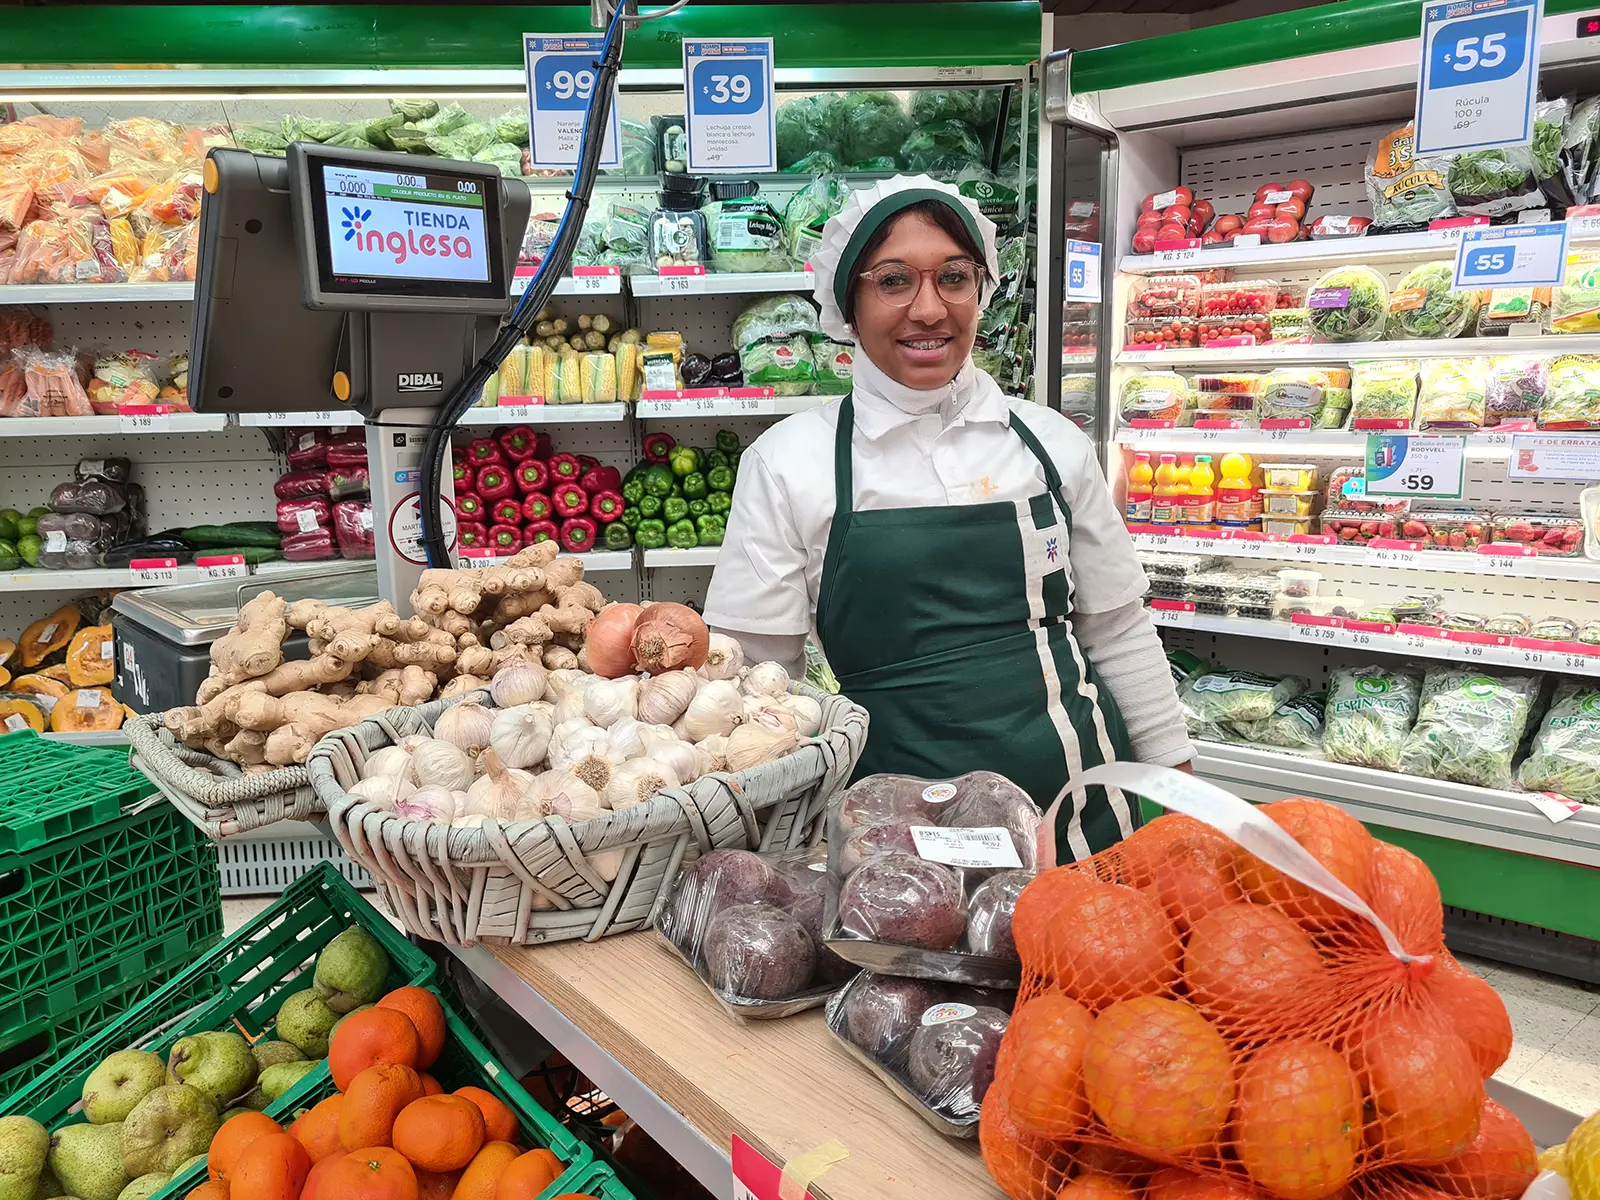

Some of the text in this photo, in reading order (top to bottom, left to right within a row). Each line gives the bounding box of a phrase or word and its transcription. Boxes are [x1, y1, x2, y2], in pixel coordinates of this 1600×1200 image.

[1455, 96, 1490, 108] Rúcula
[1454, 109, 1482, 119] 100 g
[706, 123, 731, 131] Lechuga
[731, 130, 755, 138] lechuga
[403, 210, 471, 230] TIENDA
[1449, 229, 1461, 239] 69
[355, 221, 473, 264] inglesa
[1162, 251, 1195, 261] KG. $ 124
[586, 280, 601, 289] $ 95
[671, 280, 690, 290] $ 163
[398, 373, 442, 386] DIBAL
[654, 403, 673, 412] $ 152
[697, 401, 715, 410] $ 135
[741, 401, 760, 409] $ 160
[511, 408, 529, 417] $ 108
[132, 418, 152, 427] $ 189
[1271, 431, 1288, 441] $ 97
[1487, 434, 1507, 444] $ 53
[1401, 474, 1434, 491] $59
[1150, 536, 1169, 546] $ 104
[1195, 540, 1215, 550] $ 104
[1296, 546, 1316, 555] $ 109
[1376, 551, 1390, 560] KG.
[1392, 552, 1397, 561] $
[472, 559, 477, 569] $
[478, 559, 491, 569] 207
[1490, 559, 1514, 568] $ 144
[141, 571, 173, 580] KG. $ 113
[221, 569, 227, 577] $
[227, 568, 237, 577] 96
[1161, 612, 1179, 621] $ 143
[1299, 627, 1335, 639] KG. $ 759
[1352, 634, 1370, 644] $ 65
[1464, 646, 1483, 656] $ 69
[1524, 652, 1543, 663] $ 61
[1565, 657, 1585, 668] $ 84
[1335, 697, 1407, 713] ESPINACA
